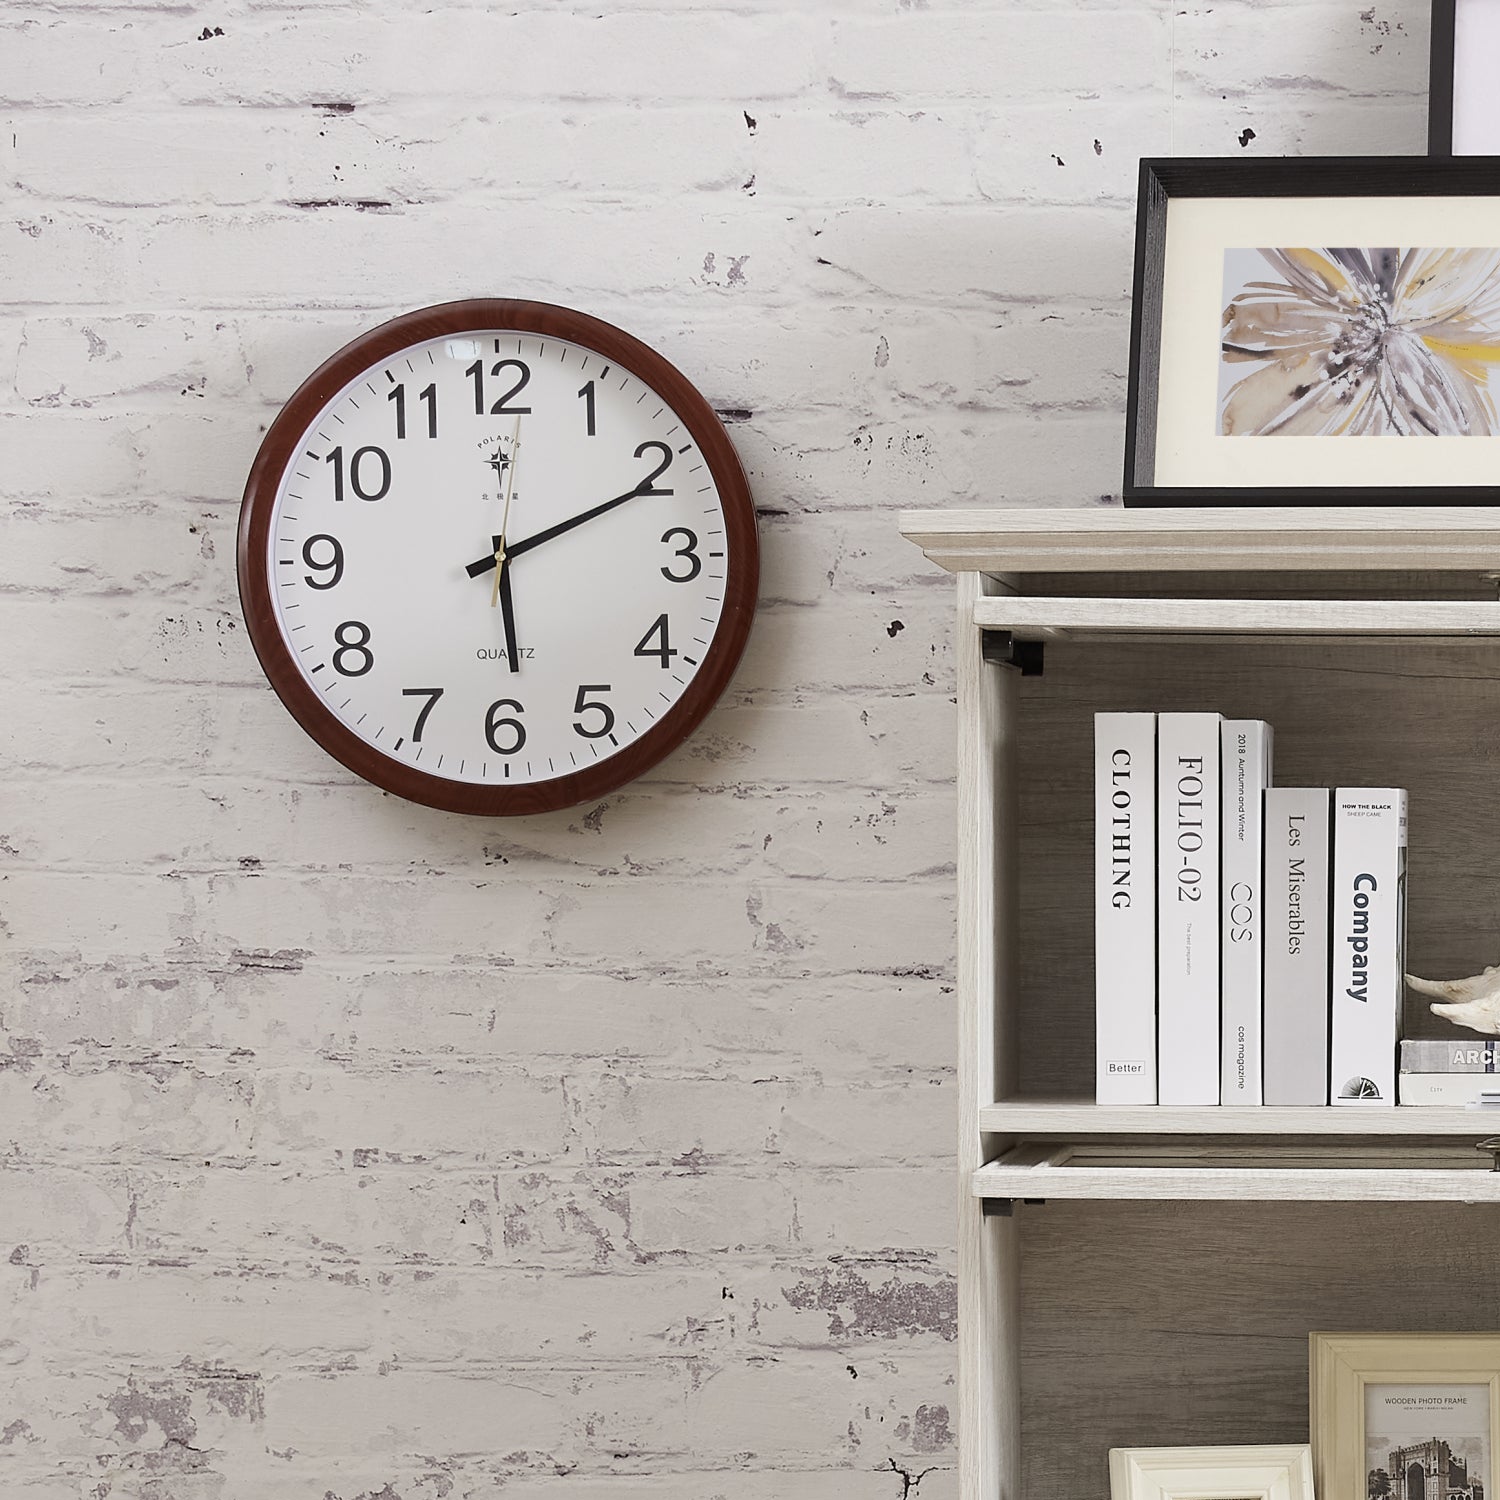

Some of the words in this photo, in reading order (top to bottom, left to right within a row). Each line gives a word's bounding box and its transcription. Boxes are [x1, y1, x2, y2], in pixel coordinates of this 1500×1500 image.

[388, 383, 438, 439] 11
[465, 359, 532, 415] 12
[577, 380, 596, 436] 1
[477, 435, 521, 449] POLARIS
[633, 441, 674, 496] 2
[326, 446, 392, 502] 10
[302, 534, 344, 590] 9
[660, 527, 702, 583] 3
[332, 621, 375, 677] 8
[477, 648, 535, 660] QUATZ
[634, 614, 678, 669] 4
[402, 688, 444, 742] 7
[484, 699, 527, 754] 6
[572, 684, 615, 738] 5
[1238, 734, 1246, 754] 2018
[1111, 749, 1132, 910] CLOTHING
[1177, 756, 1203, 903] FOLIO-02
[1289, 815, 1306, 847] Les
[1230, 882, 1253, 943] COS
[1289, 858, 1306, 955] Miserables
[1346, 873, 1377, 1003] Company
[1109, 1061, 1142, 1074] Better
[1237, 1043, 1245, 1089] magazine
